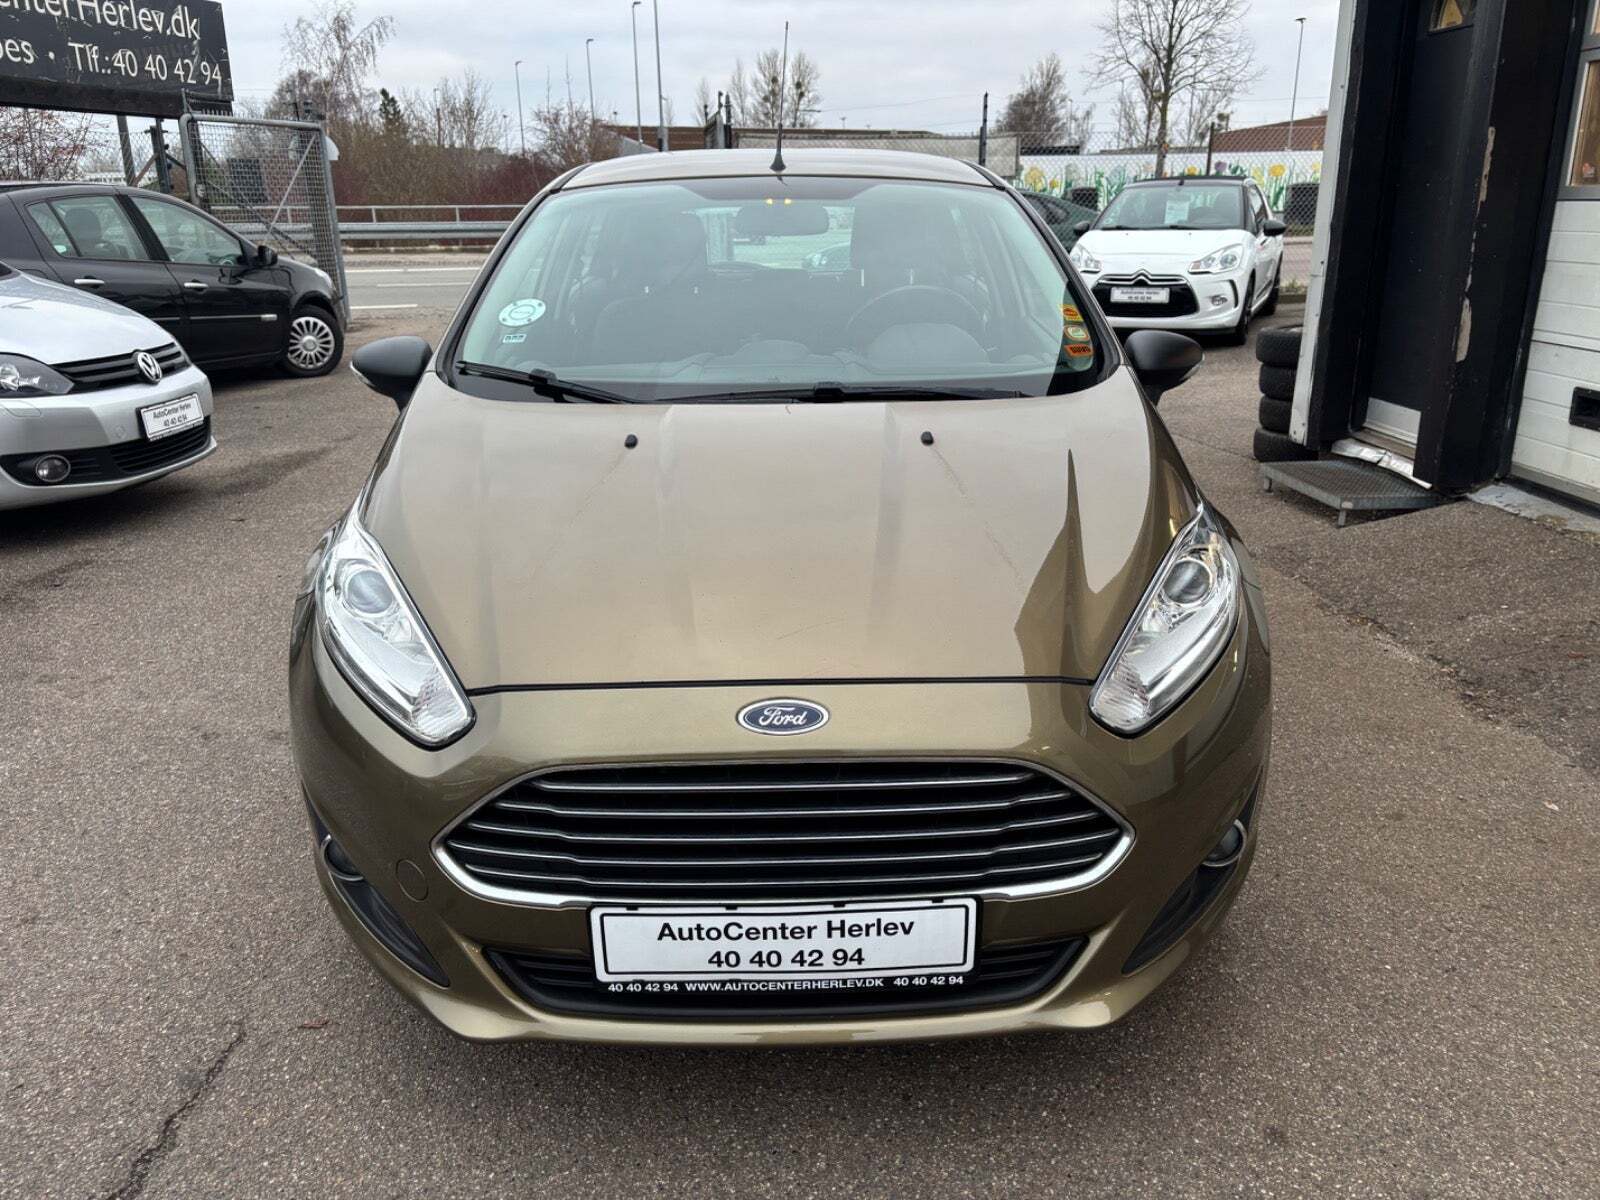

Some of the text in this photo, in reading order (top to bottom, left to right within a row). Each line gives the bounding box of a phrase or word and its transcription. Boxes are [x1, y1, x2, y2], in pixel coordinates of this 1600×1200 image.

[0, 39, 34, 64] es
[144, 54, 168, 81] 40
[174, 58, 197, 84] 42
[200, 61, 223, 87] 94
[758, 706, 808, 726] Ford
[657, 918, 914, 942] AutoCenter Herlev
[708, 948, 865, 968] 40 40 42 94
[608, 975, 964, 993] 40 40 42 94 WWW.AUTOCENTERHERLEV.DK 40 40 42 94
